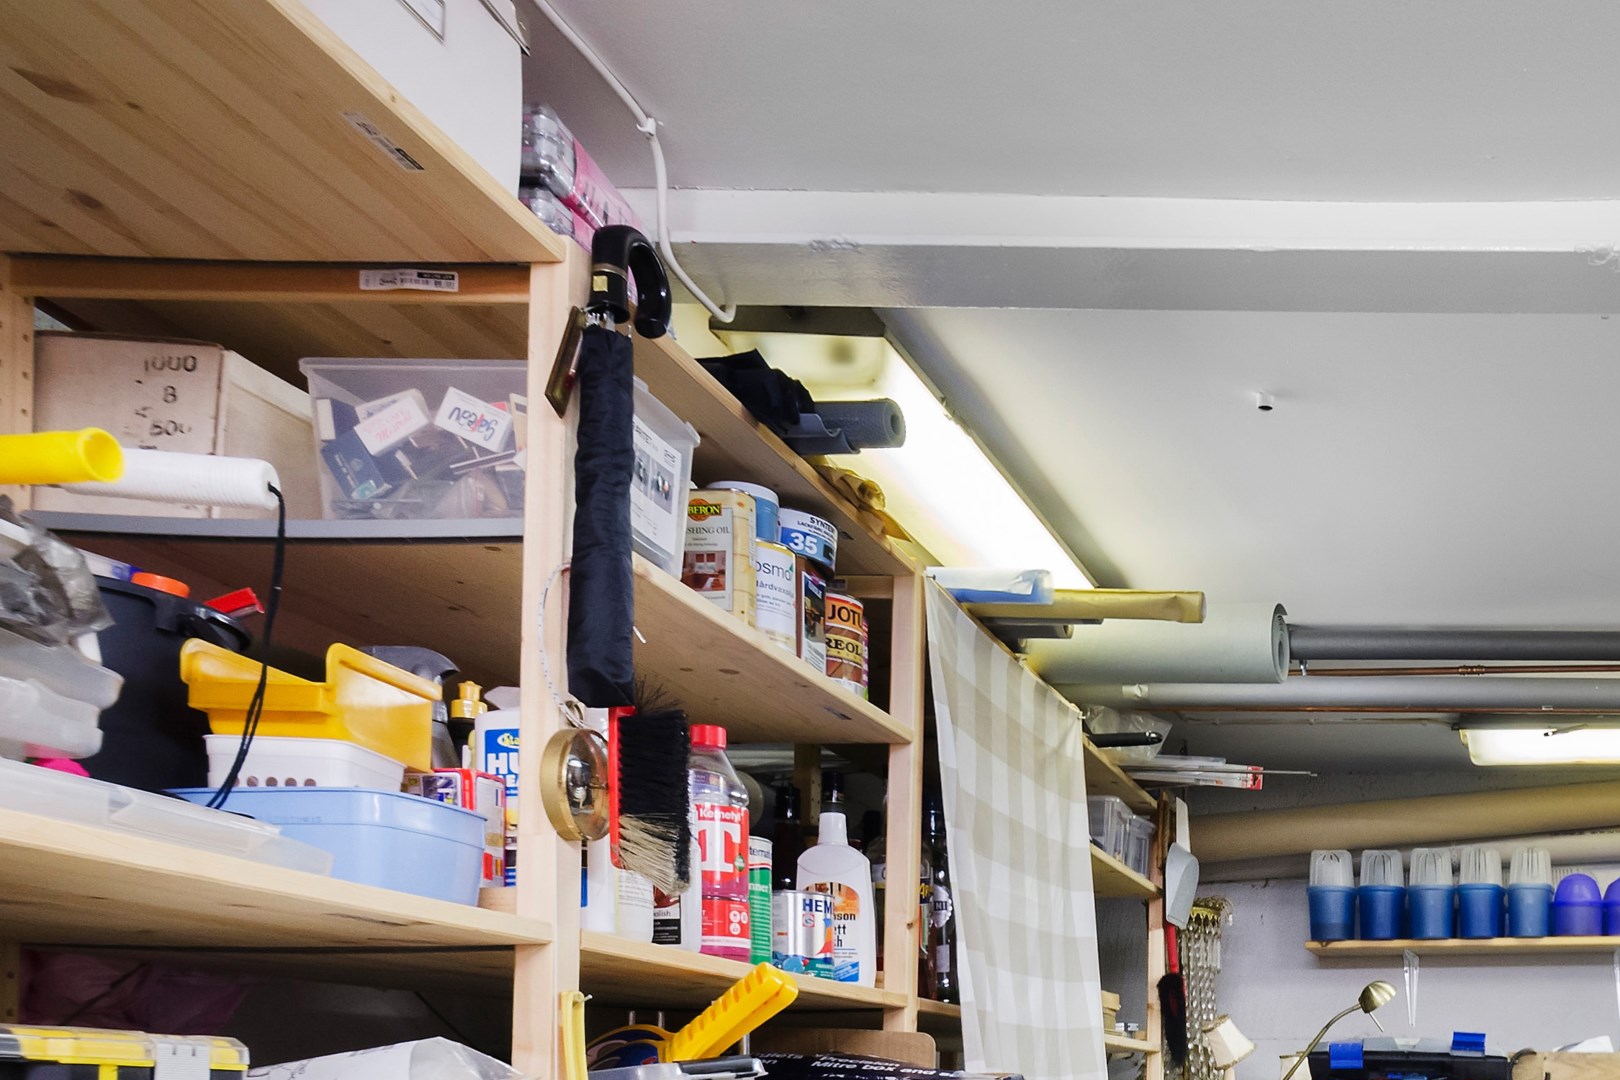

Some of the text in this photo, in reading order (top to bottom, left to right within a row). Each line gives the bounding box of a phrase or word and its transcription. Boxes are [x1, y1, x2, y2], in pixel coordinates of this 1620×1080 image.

[688, 504, 721, 515] BERON
[788, 532, 818, 555] 35
[755, 560, 792, 582] osmo
[825, 638, 864, 657] REOL
[802, 898, 832, 914] HEM
[811, 1060, 857, 1070] Mitre
[861, 1063, 896, 1073] box
[900, 1067, 937, 1077] and
